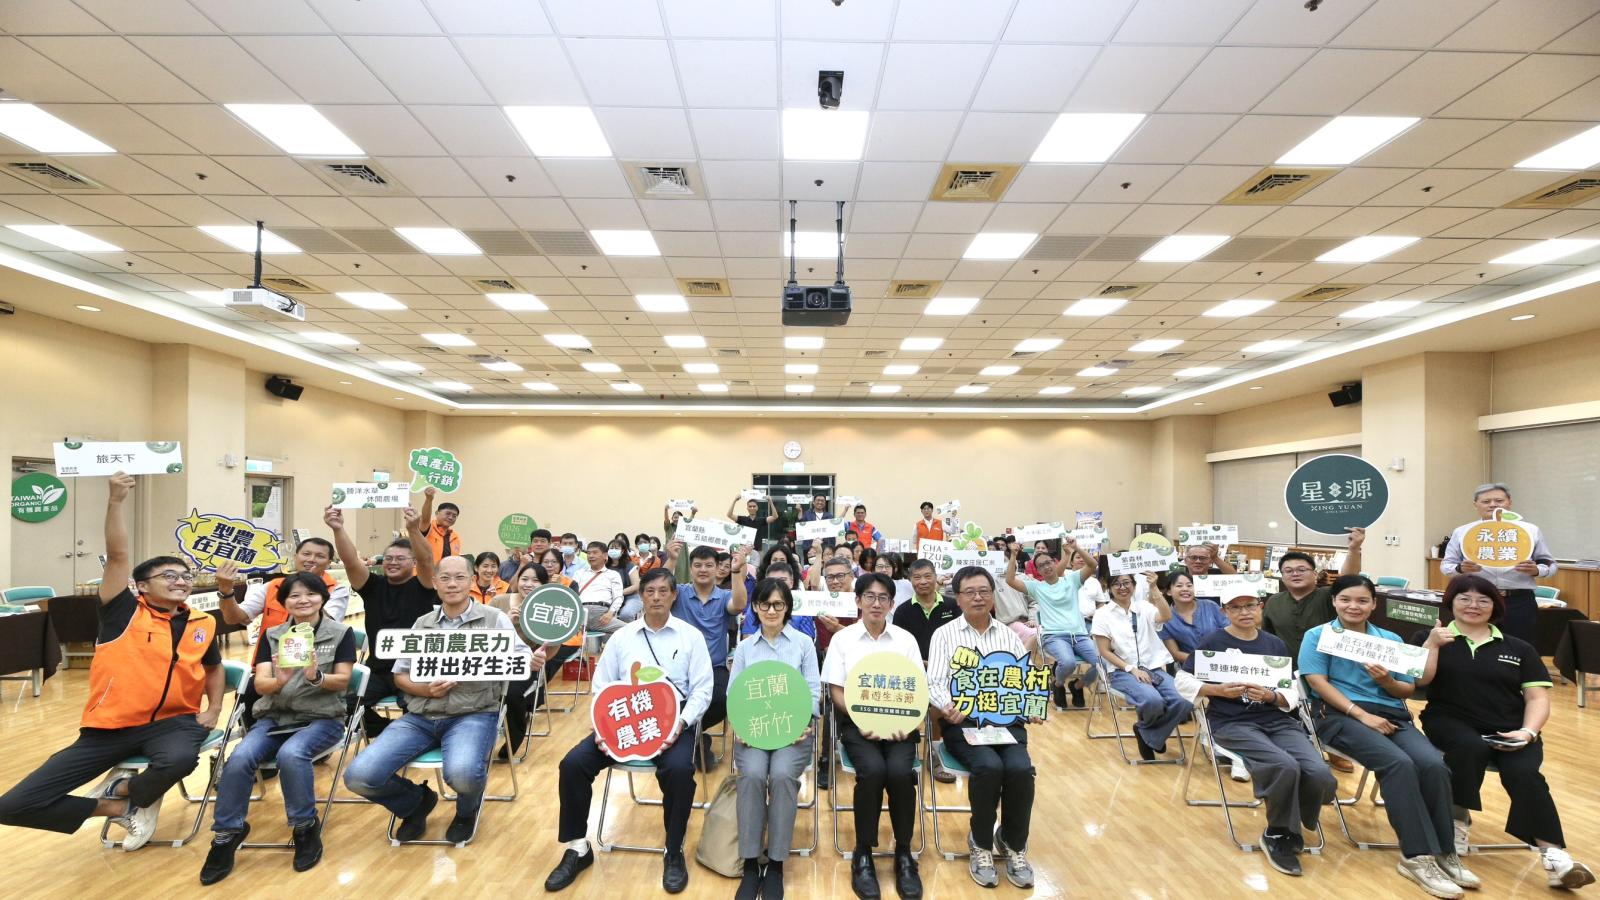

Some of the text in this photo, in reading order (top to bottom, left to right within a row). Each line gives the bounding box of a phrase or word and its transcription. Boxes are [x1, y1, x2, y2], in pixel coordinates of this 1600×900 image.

[96, 454, 135, 464] 旅天下
[415, 454, 456, 472] 農產品
[428, 472, 454, 487] 行銷
[17, 505, 58, 514] 有機農產品
[1310, 504, 1334, 512] XING
[211, 522, 255, 547] 型農
[1477, 528, 1518, 543] 永續
[192, 535, 258, 565] 在宜蘭
[922, 544, 942, 552] CHA
[1477, 547, 1518, 560] 農業
[529, 602, 574, 628] 宜蘭
[416, 656, 526, 677] 拼出好生活
[1209, 662, 1270, 677] 雙連埤合作社
[744, 673, 789, 700] 宜蘭
[858, 673, 916, 692] 宜蘭嚴選
[952, 665, 1051, 691] 食在農村
[607, 688, 654, 722] 有機
[952, 692, 1048, 721] 力挺宜蘭
[616, 718, 662, 750] 農業
[748, 711, 794, 739] 新竹
